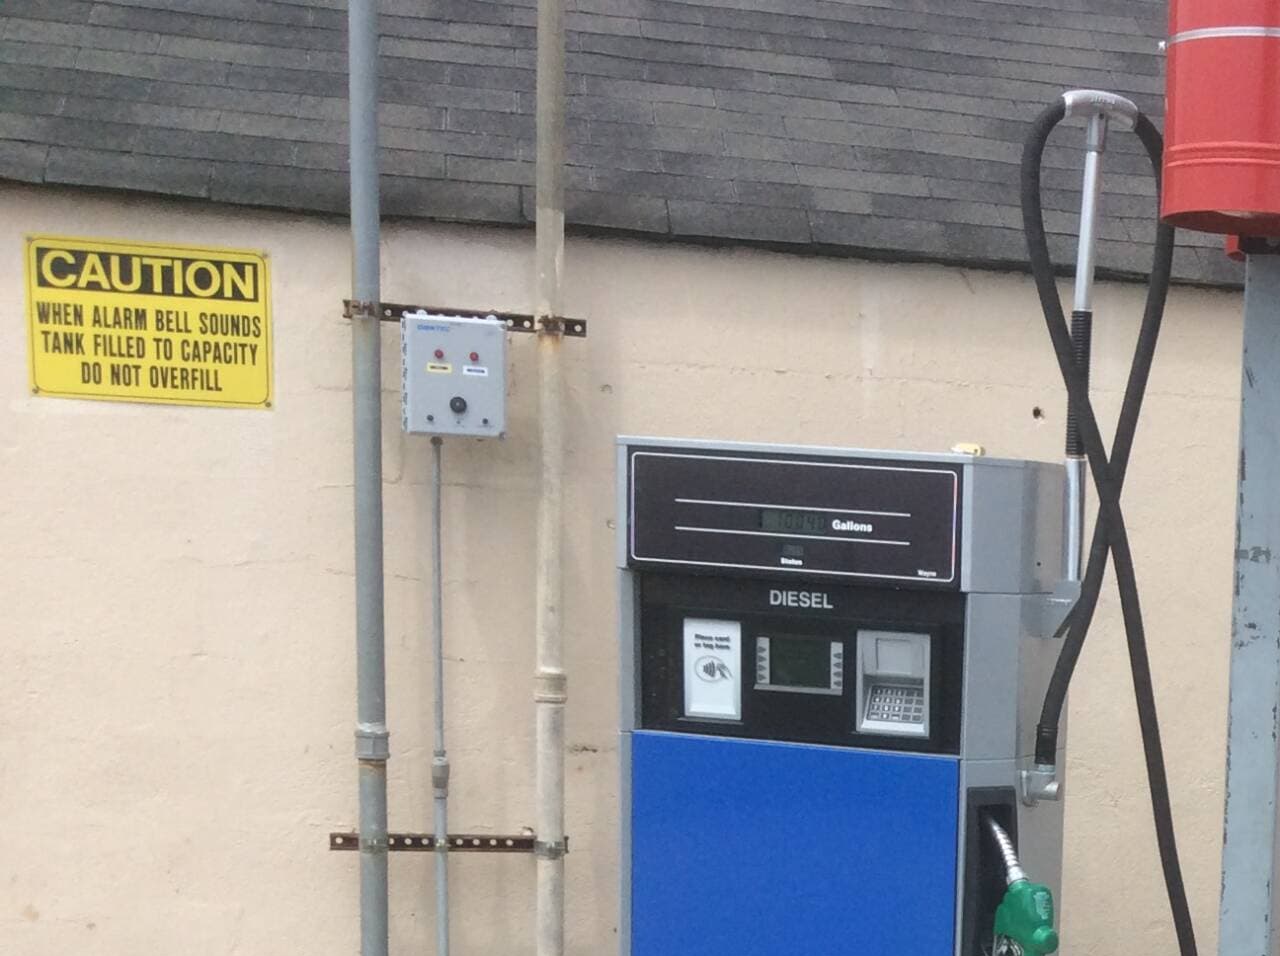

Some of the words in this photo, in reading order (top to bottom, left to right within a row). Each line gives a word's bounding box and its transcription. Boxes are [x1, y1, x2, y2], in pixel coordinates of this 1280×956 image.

[41, 249, 255, 300] CAUTION
[36, 301, 84, 327] WHEN
[92, 305, 148, 331] ALARM
[155, 310, 192, 334] BELL
[199, 312, 261, 338] SOUNDS
[41, 330, 85, 355] TANK
[94, 334, 145, 359] FILLED
[153, 338, 173, 361] TO
[181, 340, 258, 366] CAPACITY
[81, 361, 101, 385] DO
[110, 364, 141, 387] NOT
[150, 365, 222, 392] OVERFILL
[832, 519, 873, 533] Gallons
[769, 589, 834, 609] DIESEL
